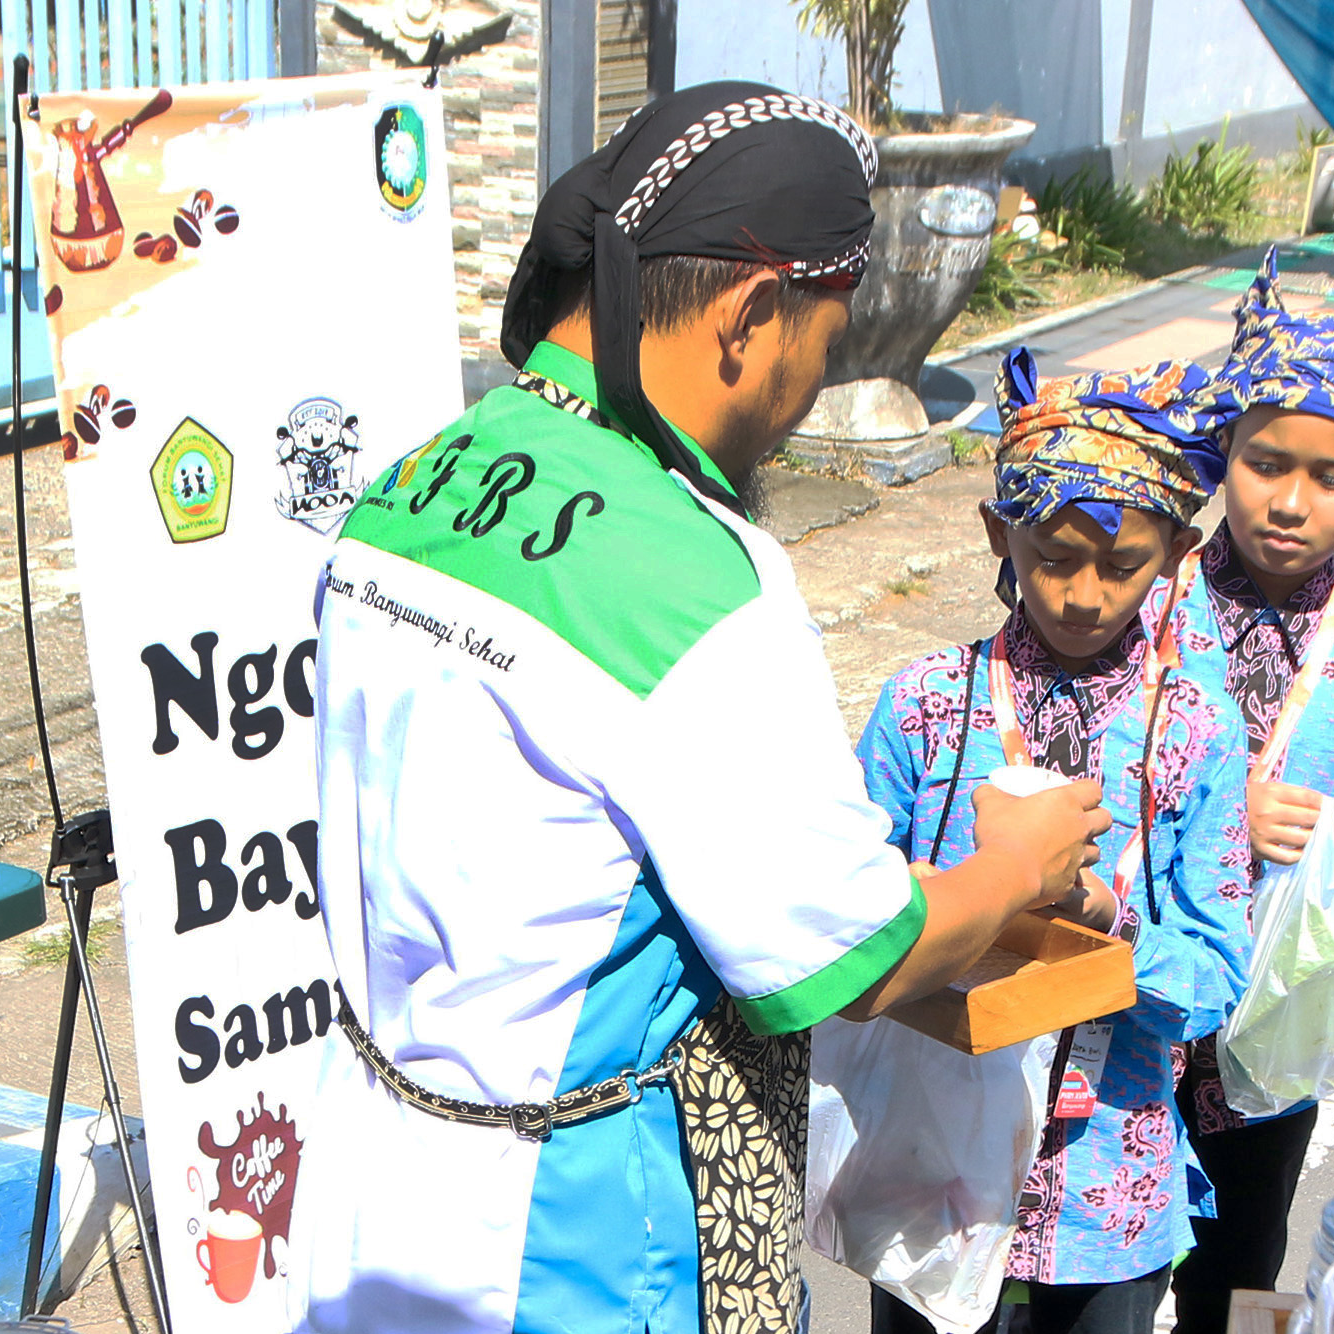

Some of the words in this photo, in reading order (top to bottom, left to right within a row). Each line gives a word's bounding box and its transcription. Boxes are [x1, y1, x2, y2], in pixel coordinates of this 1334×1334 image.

[360, 581, 457, 647] Banyuwangi
[459, 628, 516, 673] Sehat
[175, 978, 344, 1083] Sam
[232, 1134, 286, 1188] Coffee
[248, 1169, 286, 1215] Time
